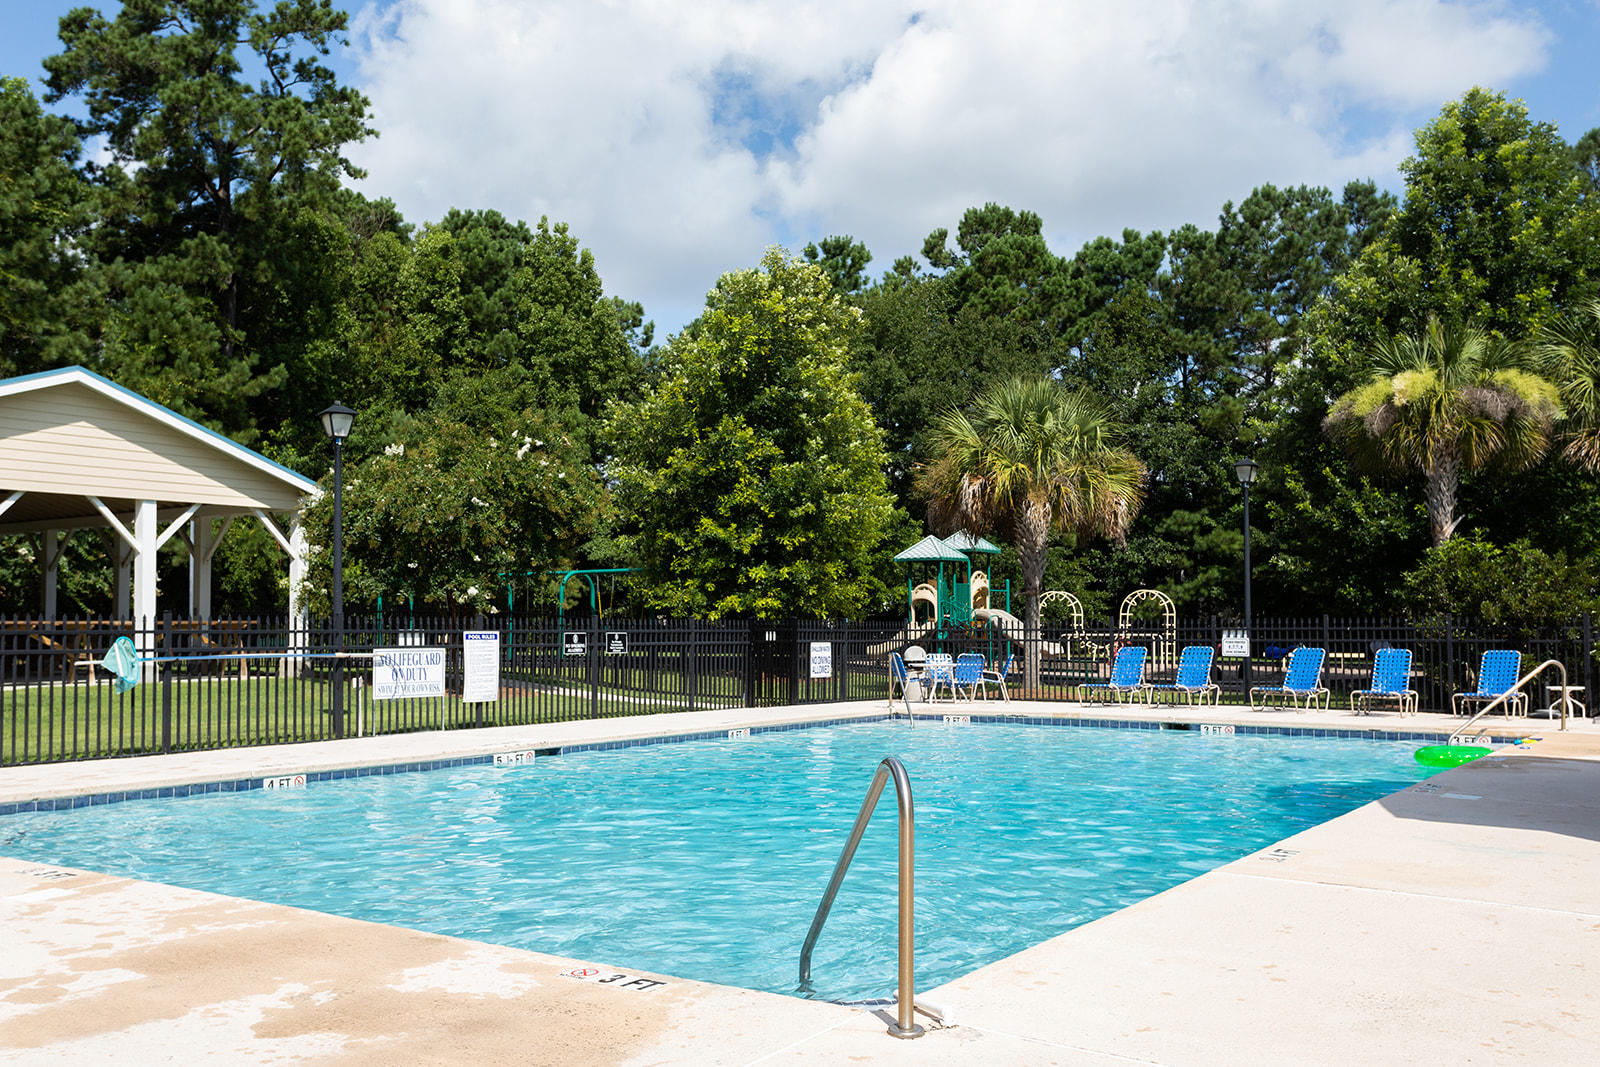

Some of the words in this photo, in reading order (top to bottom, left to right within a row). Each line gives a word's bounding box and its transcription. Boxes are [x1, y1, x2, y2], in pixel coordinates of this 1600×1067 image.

[394, 653, 441, 666] LIFEGUARD
[392, 668, 404, 681] ON
[406, 668, 427, 681] DUTY
[812, 665, 830, 674] ALLOWED
[516, 754, 524, 764] FT
[268, 780, 274, 788] 4
[280, 778, 291, 788] FT
[598, 974, 626, 983] 3
[620, 978, 668, 990] FT
